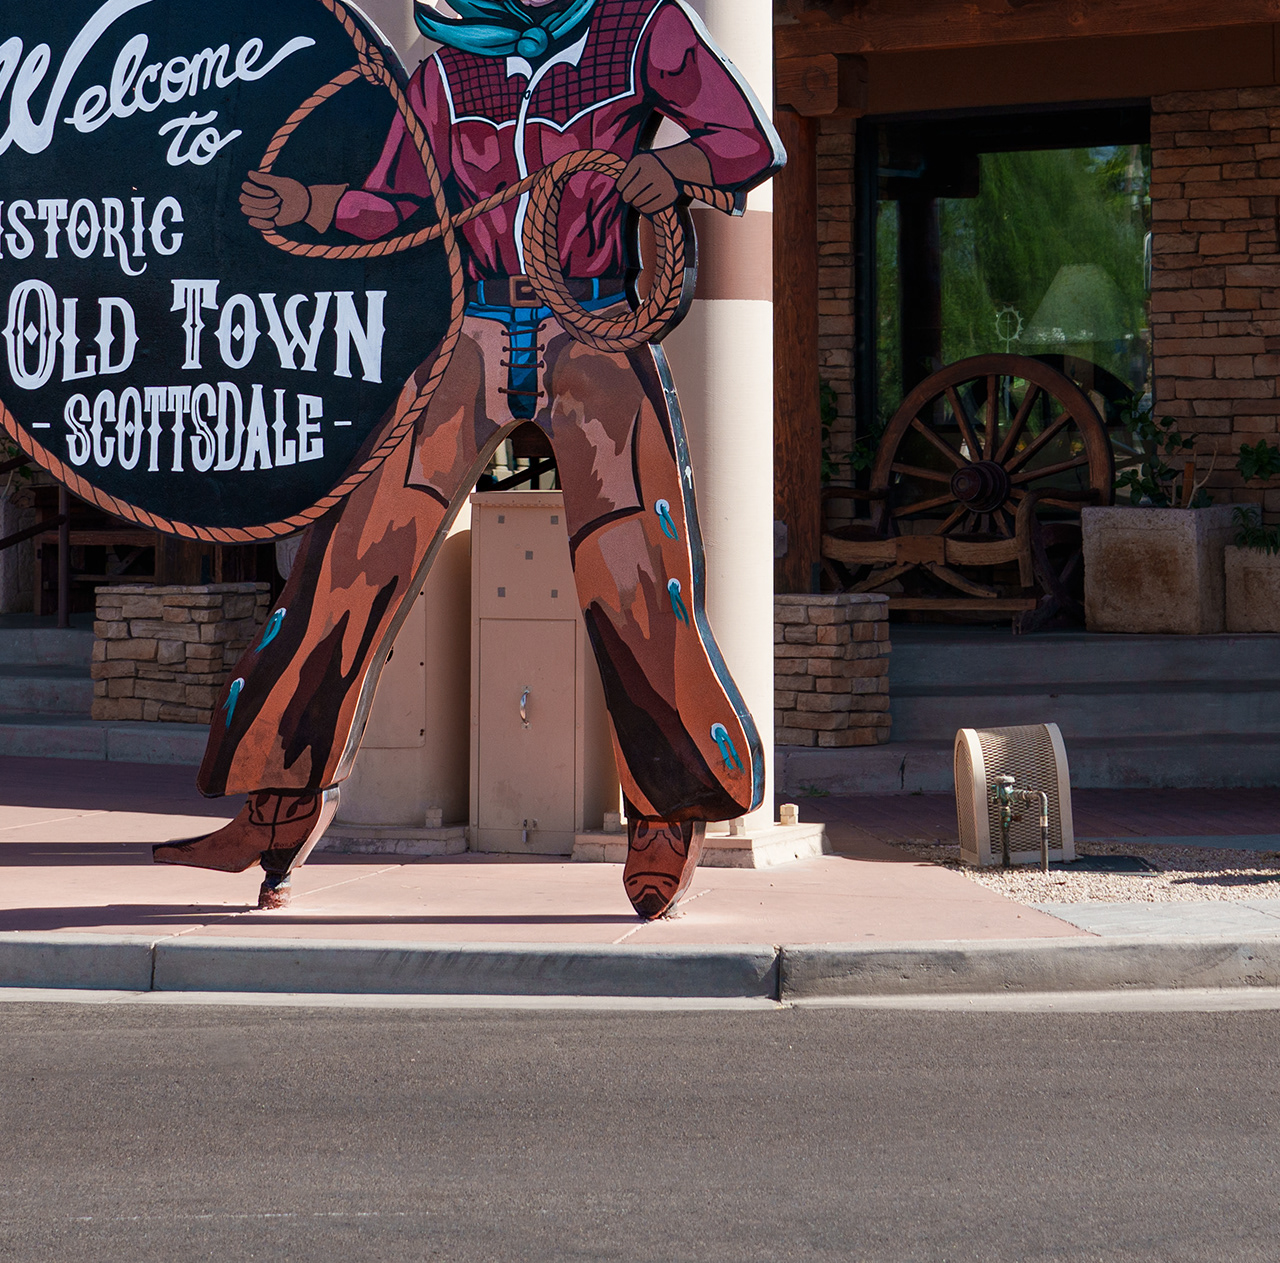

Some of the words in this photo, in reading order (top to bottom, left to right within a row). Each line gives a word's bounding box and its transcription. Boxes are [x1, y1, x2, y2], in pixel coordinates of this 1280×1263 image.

[158, 111, 242, 166] to
[1, 279, 140, 390] OLD
[169, 279, 387, 384] TOWN
[64, 382, 324, 472] SCOTTSDALE
